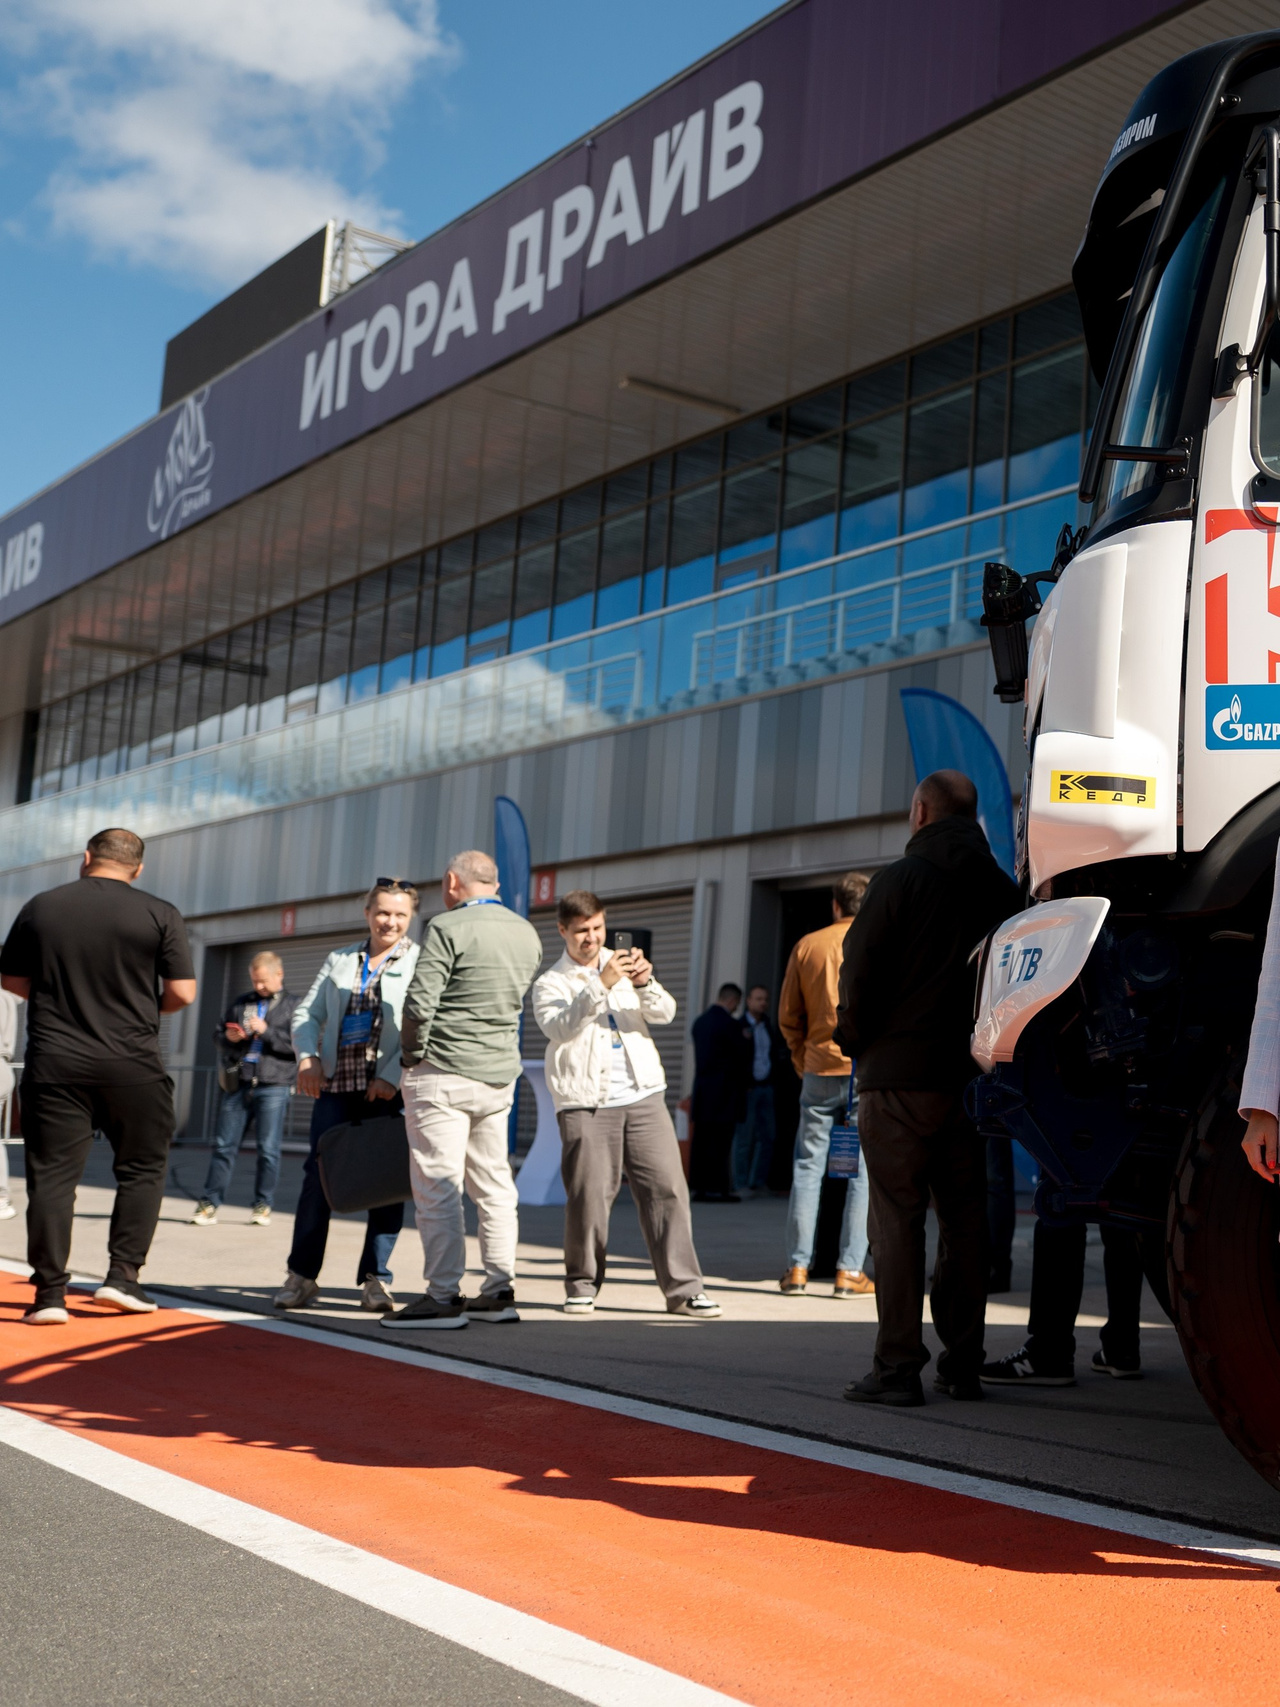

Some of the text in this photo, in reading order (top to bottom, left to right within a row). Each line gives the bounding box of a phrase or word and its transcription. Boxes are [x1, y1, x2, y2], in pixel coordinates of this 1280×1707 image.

[300, 80, 764, 431] ИГОРА ДРАЙВ
[0, 521, 44, 599] ЙВ
[1059, 790, 1147, 804] КЕДР
[1007, 947, 1043, 984] VTB
